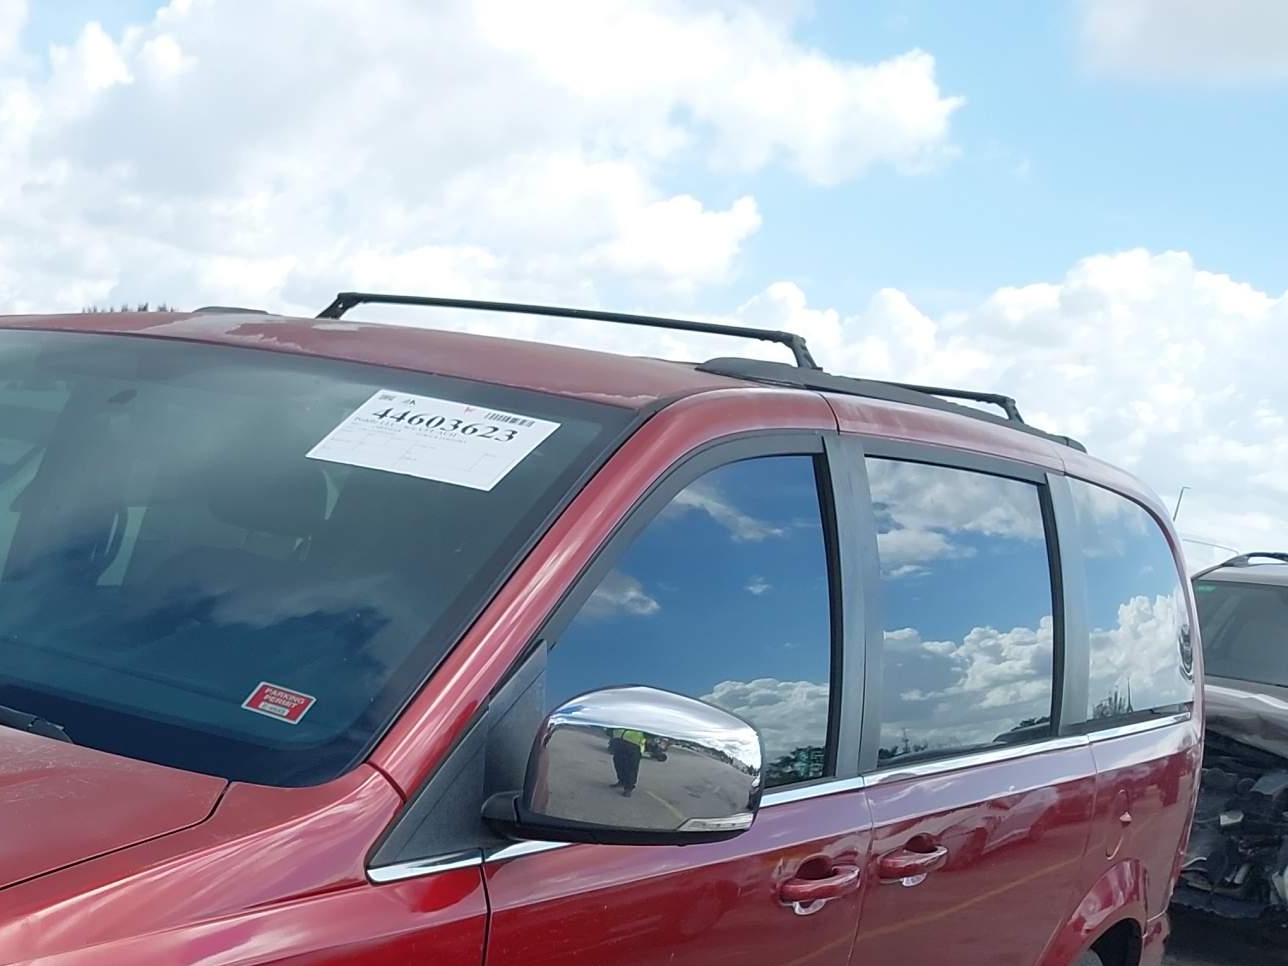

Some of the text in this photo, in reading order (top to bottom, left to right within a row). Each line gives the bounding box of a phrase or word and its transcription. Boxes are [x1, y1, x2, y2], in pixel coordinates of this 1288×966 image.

[372, 407, 519, 442] 44603623
[263, 694, 298, 709] PERMIT
[264, 687, 306, 705] PARKING
